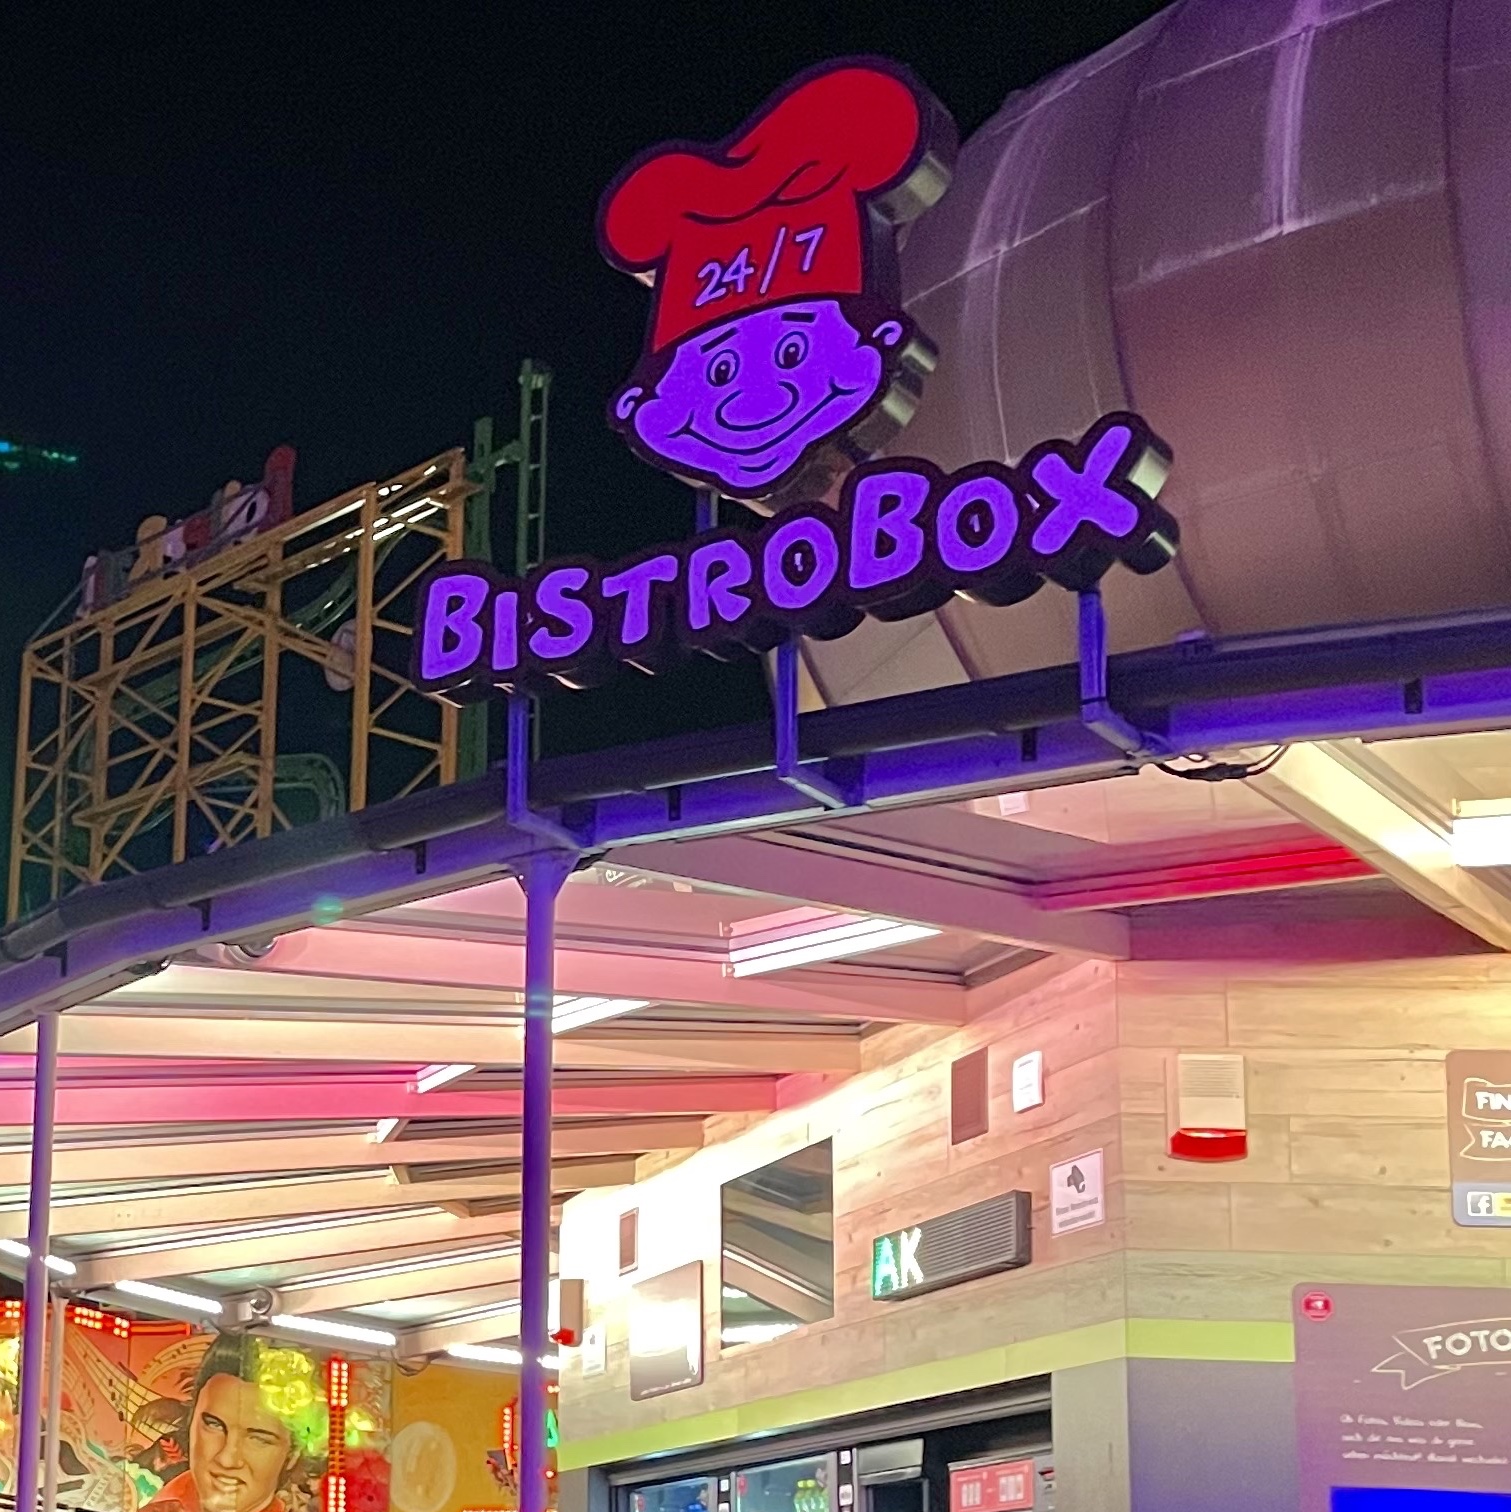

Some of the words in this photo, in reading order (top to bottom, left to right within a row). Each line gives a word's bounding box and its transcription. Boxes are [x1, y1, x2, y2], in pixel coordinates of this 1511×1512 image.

[695, 227, 825, 307] 24/7
[875, 1226, 924, 1297] AK
[1422, 1328, 1511, 1360] FOTO
